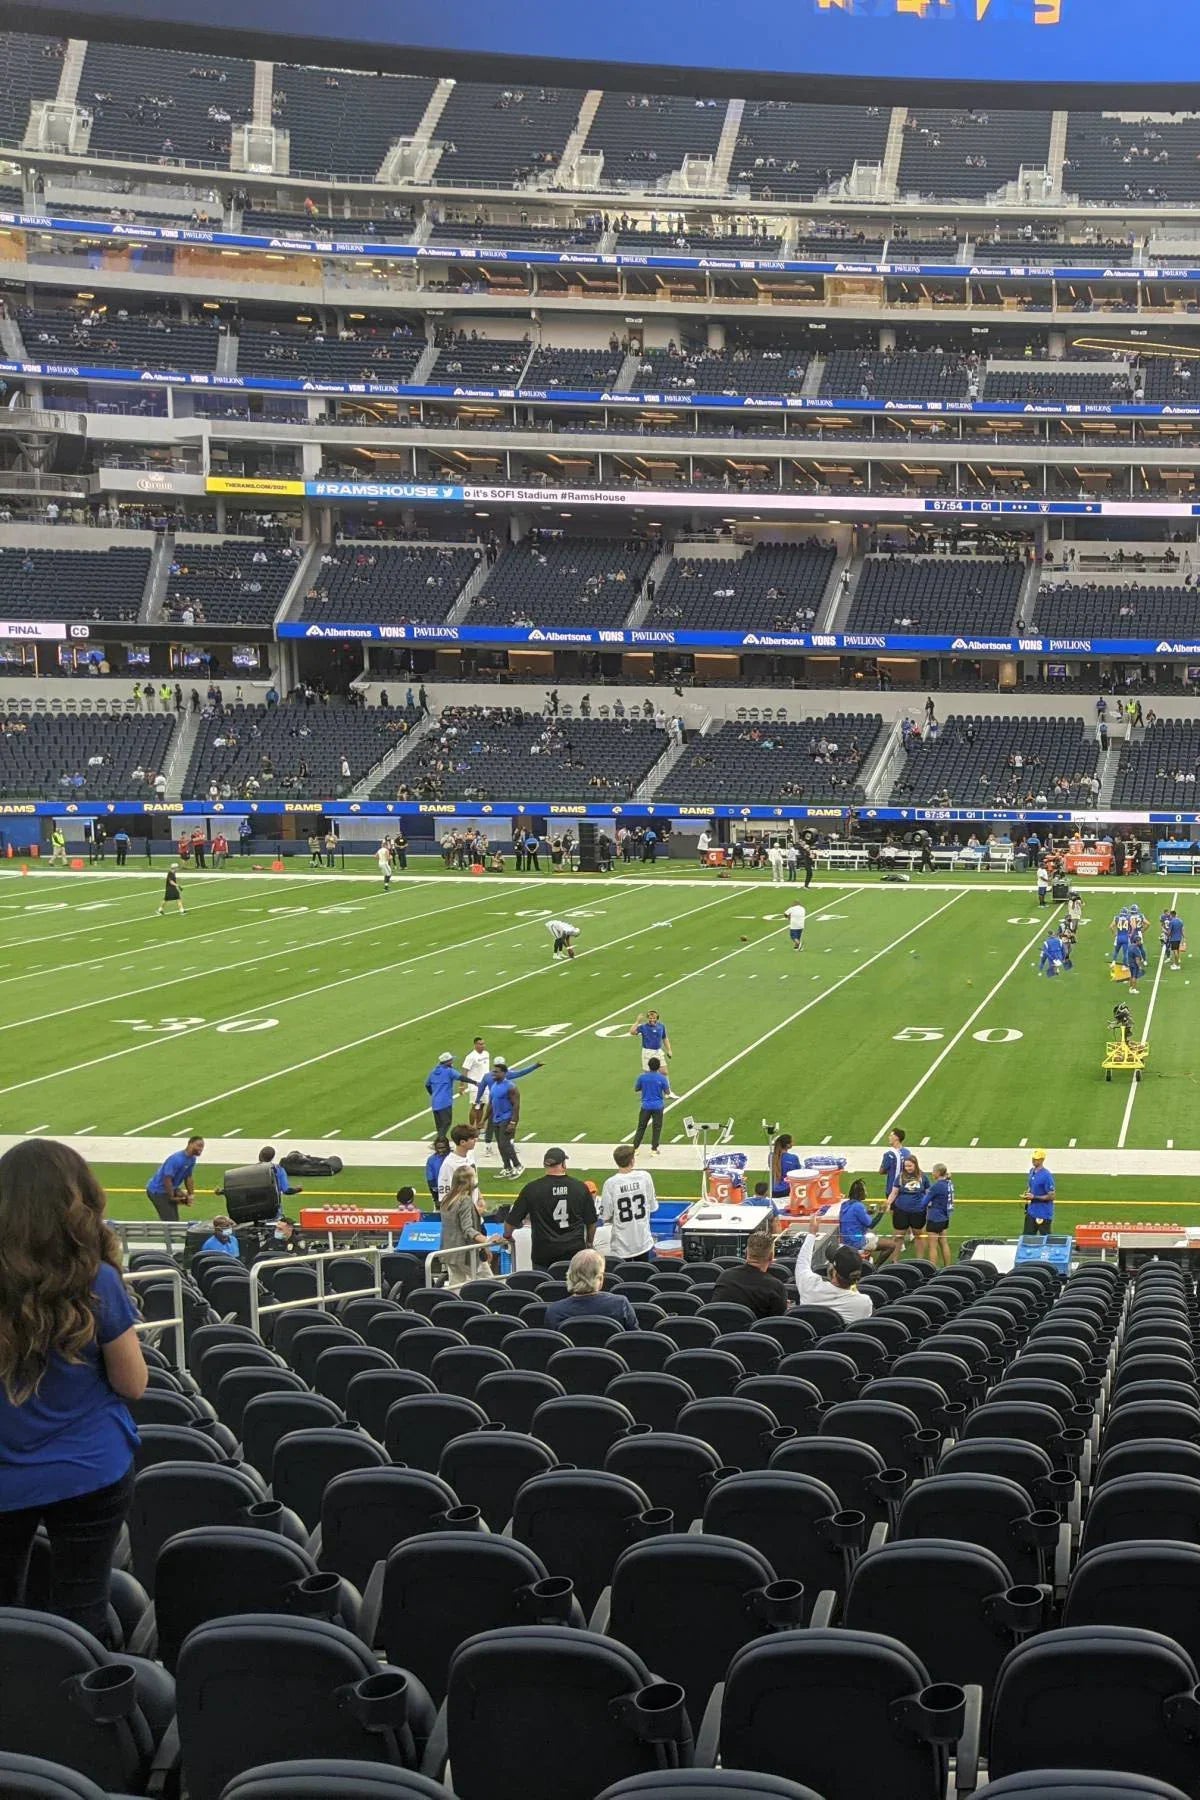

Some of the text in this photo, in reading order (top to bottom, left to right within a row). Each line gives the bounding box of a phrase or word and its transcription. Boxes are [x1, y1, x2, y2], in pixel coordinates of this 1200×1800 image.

[316, 485, 437, 497] #RAMSHOUSE
[473, 489, 488, 498] it's
[517, 491, 558, 500] Stadium
[560, 492, 626, 502] #RamsHouse
[933, 501, 963, 510] 67:54
[8, 626, 42, 635] FINAL
[72, 627, 88, 637] CC
[322, 627, 458, 638] Albertsons VONS PAVILIONS
[544, 631, 674, 642] Albertsons VONS PAVILIONS
[758, 636, 886, 647] Albertsons VONS PAVILIONS
[966, 640, 1090, 651] Albertsons VONS PAVILIONS
[144, 803, 184, 811] RAMS
[284, 803, 322, 811] RAMS
[418, 804, 456, 813] RAMS
[550, 804, 586, 813] RAMS
[678, 806, 716, 814] RAMS
[806, 808, 842, 816] RAMS
[892, 1027, 1023, 1043] 50
[818, 1175, 830, 1188] G
[553, 1187, 568, 1195] CARR
[620, 1183, 640, 1194] WALLER
[717, 1184, 730, 1196] G
[795, 1184, 808, 1198] G
[617, 1194, 647, 1223] 83
[326, 1215, 389, 1225] GATORADE
[553, 1200, 569, 1229] 4
